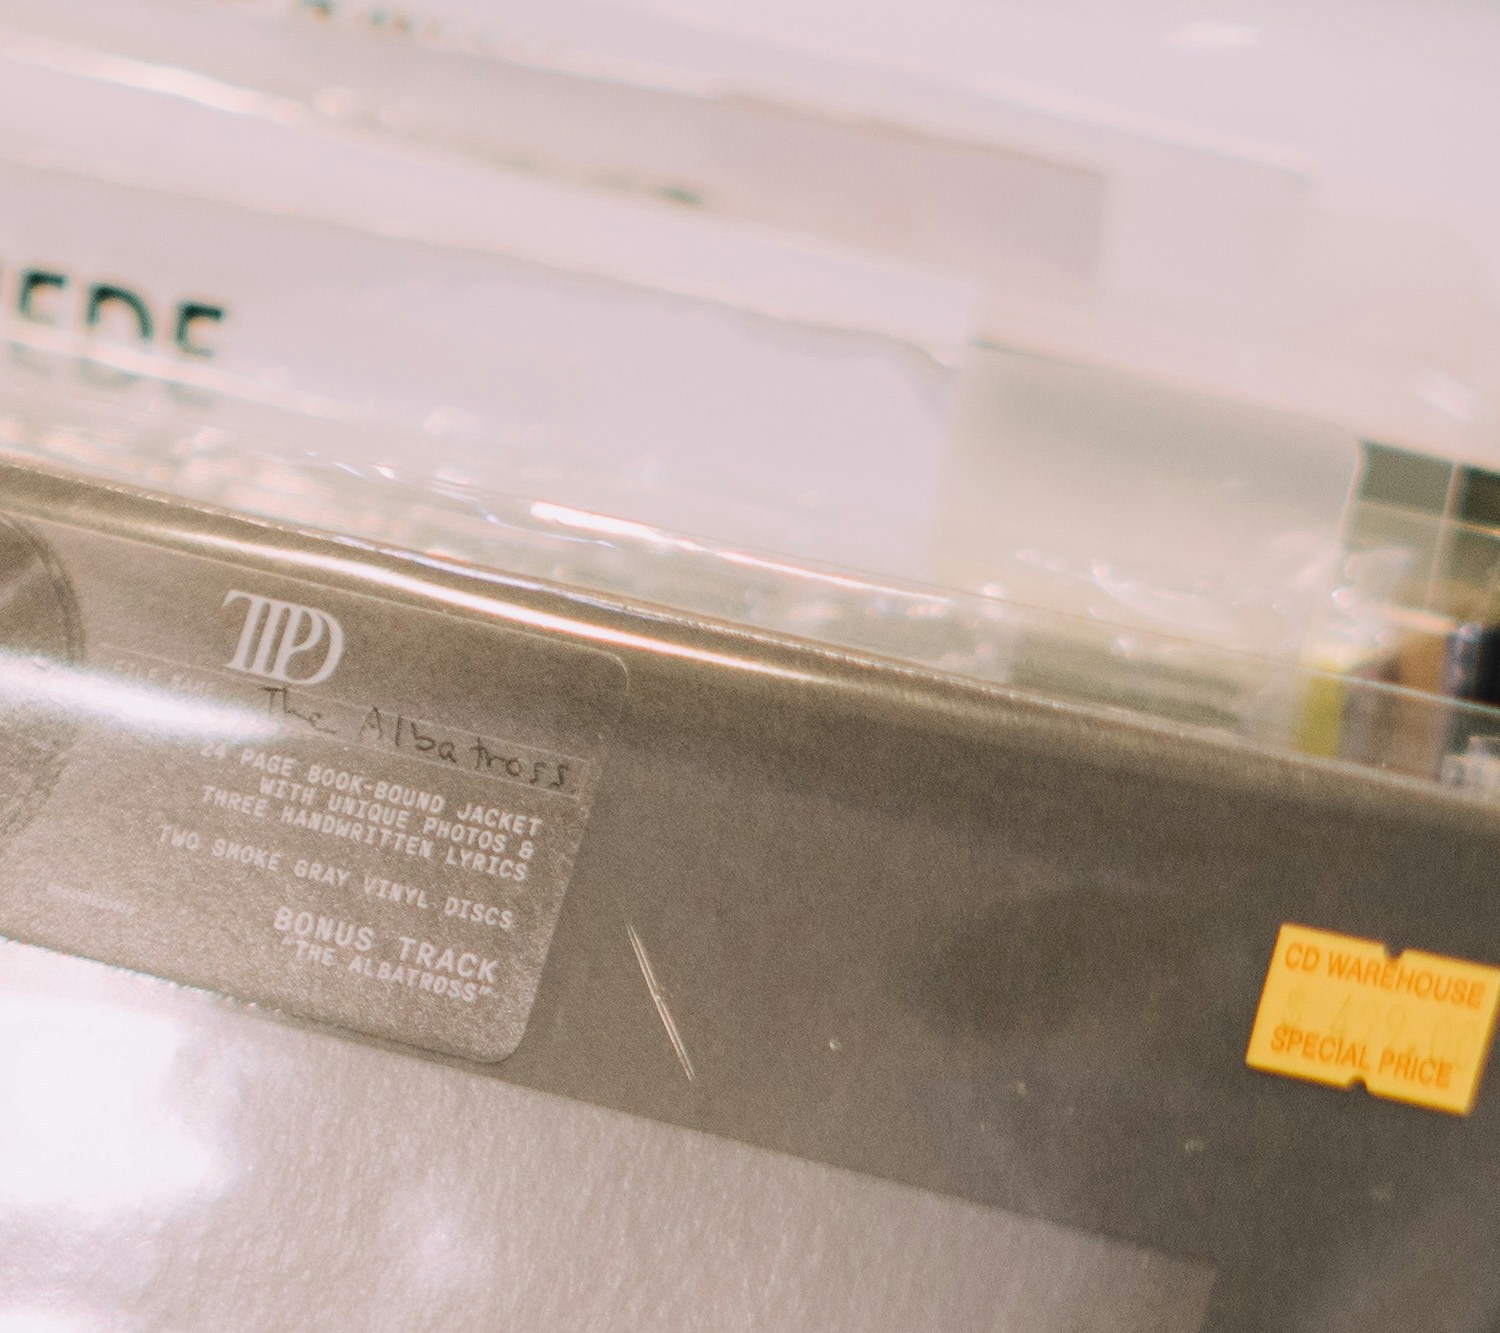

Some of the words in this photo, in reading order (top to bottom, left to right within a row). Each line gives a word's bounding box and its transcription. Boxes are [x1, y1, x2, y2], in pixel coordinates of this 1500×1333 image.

[257, 684, 337, 735] The
[202, 785, 268, 818] THREE
[281, 805, 435, 860] HANDWRITTEN
[445, 846, 528, 882] LYRICS
[240, 749, 296, 776] PAGE
[308, 764, 445, 814] BOOK-BOUND
[456, 802, 543, 837] JACKET
[260, 775, 317, 804] WITH
[329, 792, 411, 829] UNIQUE
[422, 816, 507, 854] PHOTOS
[519, 839, 534, 860] &
[158, 823, 200, 852] TWO
[211, 837, 283, 872] SMOKE
[294, 858, 351, 887] GRAY
[364, 876, 429, 909] VINYL
[443, 896, 514, 930] DISCS
[274, 905, 376, 952] BONUS
[399, 935, 500, 983] TRACK
[1284, 942, 1320, 974] CD
[1326, 950, 1487, 1010] WAREHOUSE
[1270, 1021, 1371, 1073] SPECIAL
[1377, 1047, 1453, 1090] PRICE
